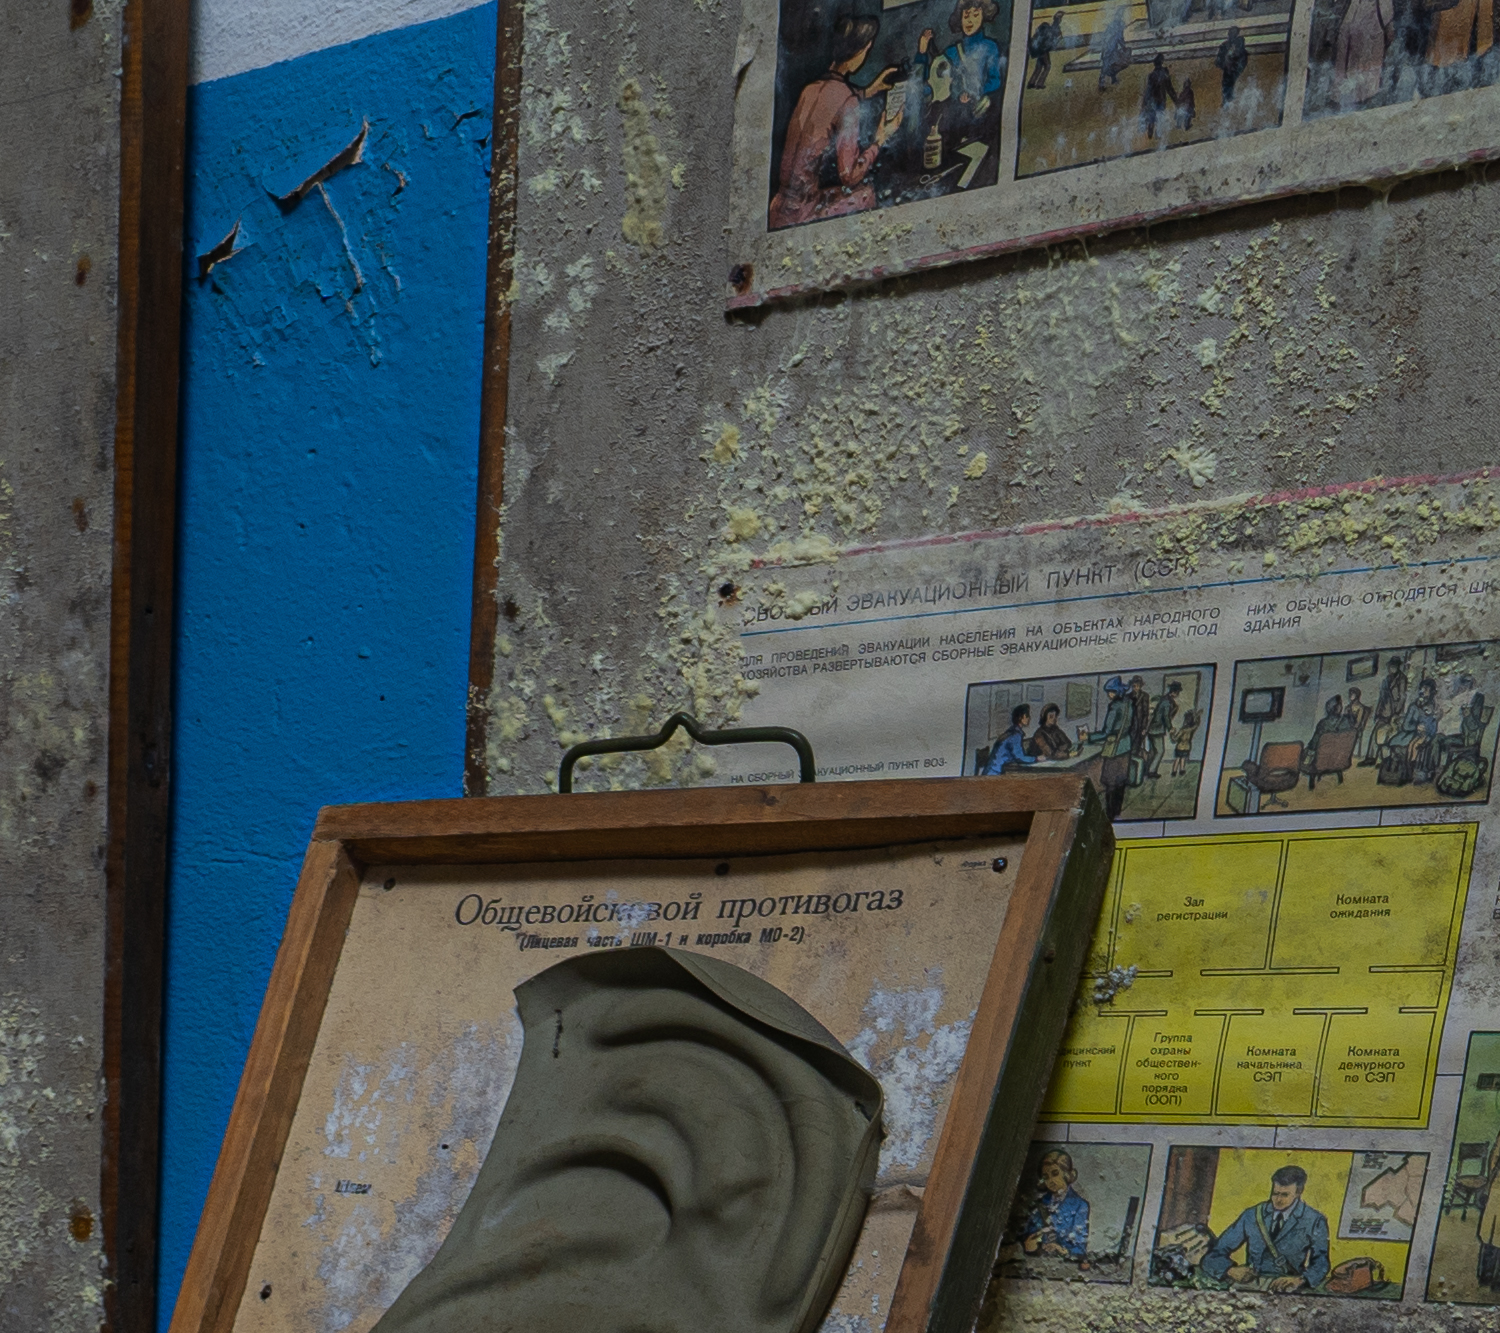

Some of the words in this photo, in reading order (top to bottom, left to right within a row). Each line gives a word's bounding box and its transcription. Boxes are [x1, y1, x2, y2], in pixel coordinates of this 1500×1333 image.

[846, 572, 1029, 611] ЭВАКУАЦИОННЫЙ
[1046, 564, 1117, 590] ПУНКТ
[1247, 602, 1277, 616] НИХ
[1243, 615, 1302, 634] ЗДАНИЯ
[771, 643, 850, 664] ПРОВЕДЕНИЯ
[858, 636, 930, 655] ЭВАКУАЦИИ
[939, 627, 1017, 646] НАСЕЛЕНИЯ
[1026, 625, 1044, 638] НА
[1053, 616, 1125, 636] ОБЪЕКТАХ
[1134, 607, 1222, 627] НАРОДНОГО
[813, 652, 926, 675] РАЗВЕРТЫВАЮТСЯ
[932, 645, 994, 662] СБОРНЫЕ
[1000, 632, 1117, 658] ЭВАКУАЦИОННЫЕ
[1187, 623, 1219, 638] ПОД
[731, 775, 744, 784] НА
[747, 769, 794, 782] СБОРНЫЙ
[888, 759, 919, 770] ПУНКТ
[716, 884, 905, 926] противогаз
[1183, 896, 1205, 908] Зал
[1336, 894, 1389, 906] Комната
[1156, 911, 1228, 923] регистрации
[1329, 908, 1391, 920] ожидания
[630, 930, 673, 949] ШМ-1
[696, 928, 752, 950] коробка
[1153, 1032, 1193, 1044] Группа
[1150, 1047, 1191, 1057] охраны
[1246, 1046, 1296, 1057] Комната
[1347, 1046, 1400, 1058] Комната
[1062, 1059, 1092, 1069] пункт
[1135, 1059, 1202, 1070] обществен-
[1236, 1059, 1302, 1070] начальника
[1338, 1060, 1405, 1071] дежурного
[1153, 1072, 1180, 1081] ного
[1253, 1071, 1282, 1083] СЭП
[1344, 1074, 1360, 1084] по
[1365, 1072, 1396, 1083] СЭП
[1141, 1083, 1188, 1094] порядка
[1145, 1094, 1183, 1107] (ООП)
